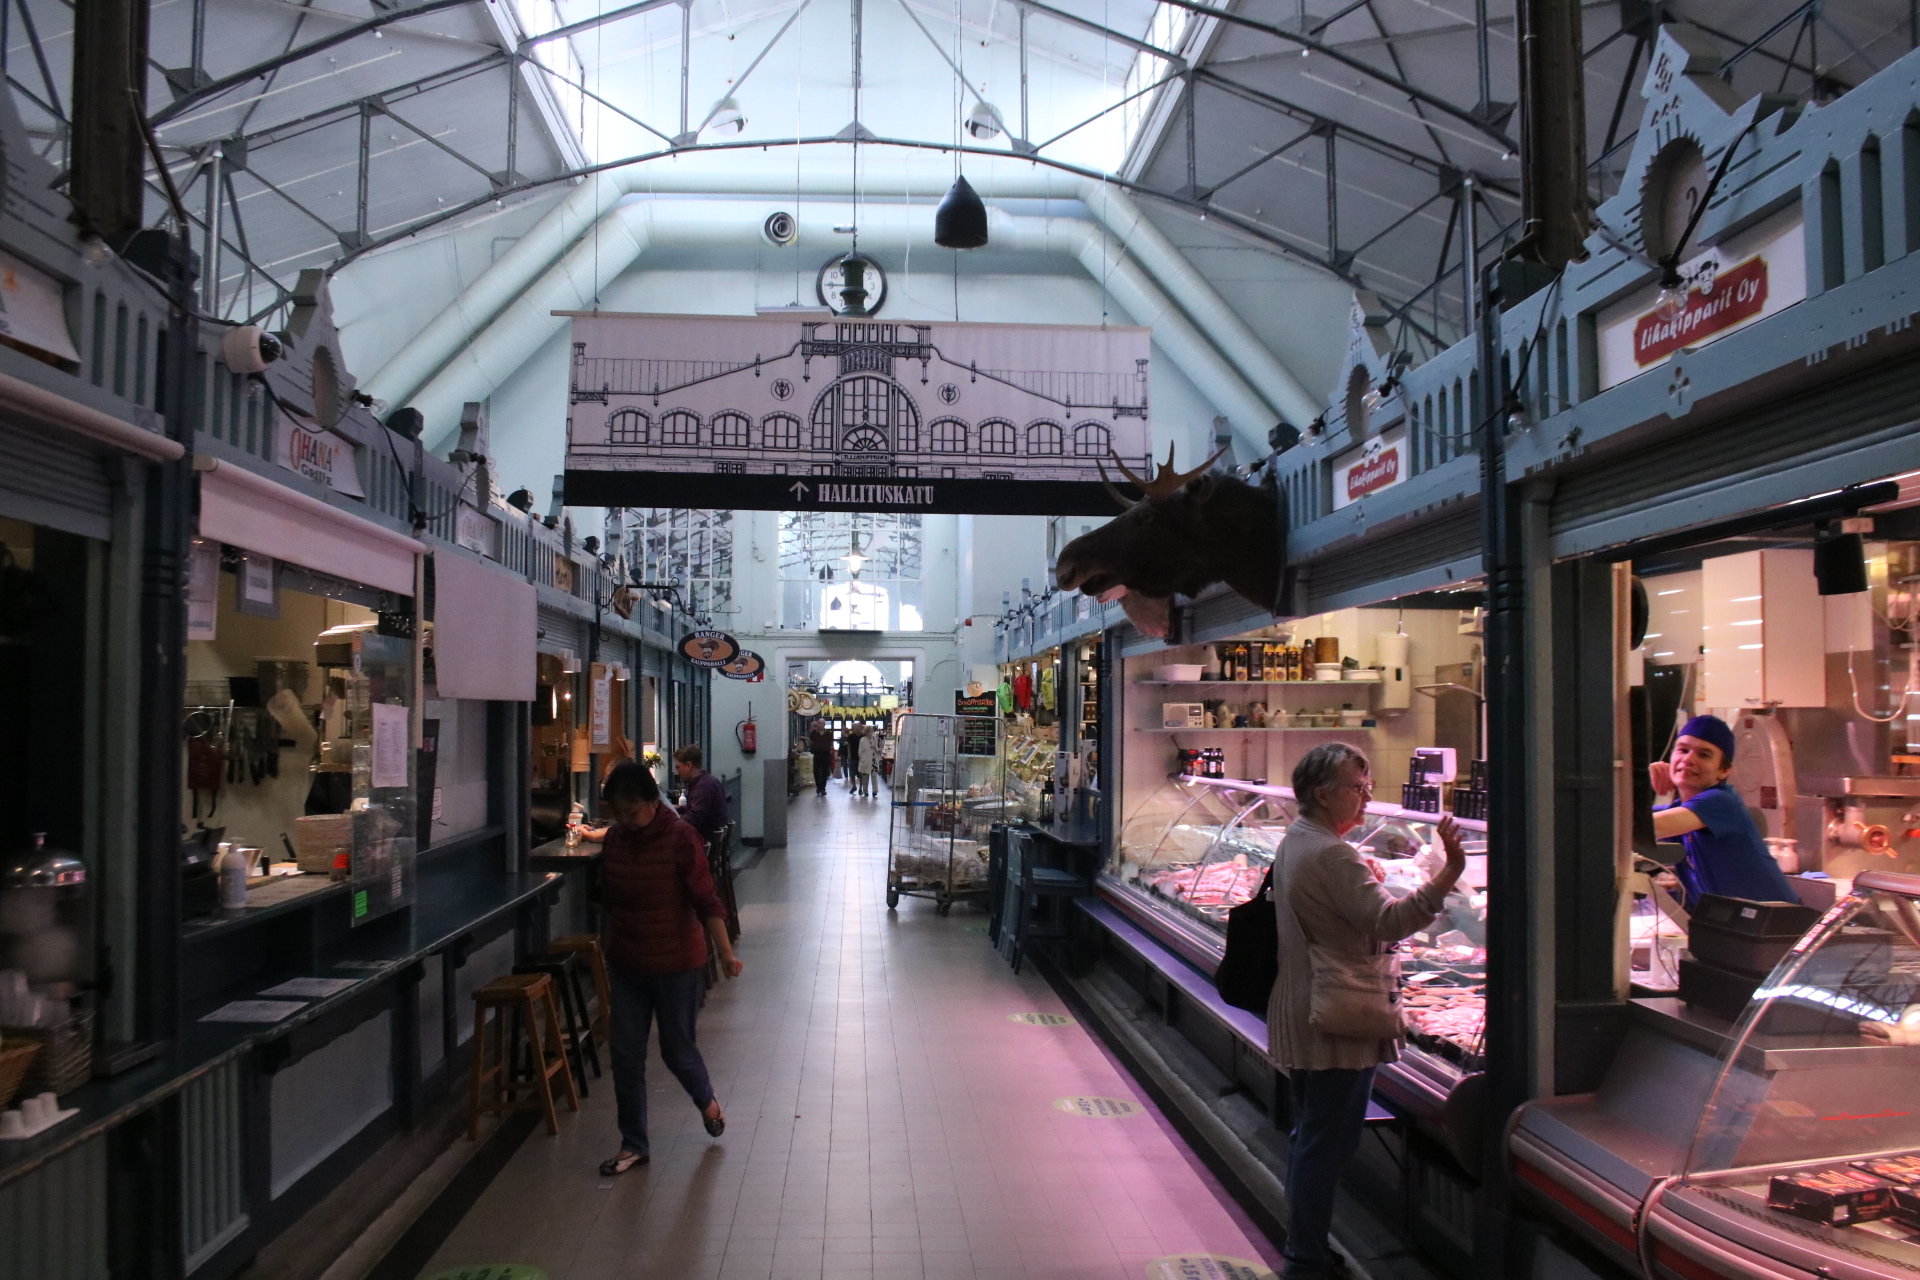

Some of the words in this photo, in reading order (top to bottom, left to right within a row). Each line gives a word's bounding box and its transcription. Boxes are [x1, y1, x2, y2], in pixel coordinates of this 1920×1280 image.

[830, 271, 838, 279] 10
[870, 282, 876, 290] 3
[1640, 285, 1734, 350] Lihakipparit
[1737, 278, 1760, 303] Oy
[290, 427, 333, 472] OHANA
[818, 483, 934, 504] HALLITUSKATU
[694, 631, 725, 640] RANGER
